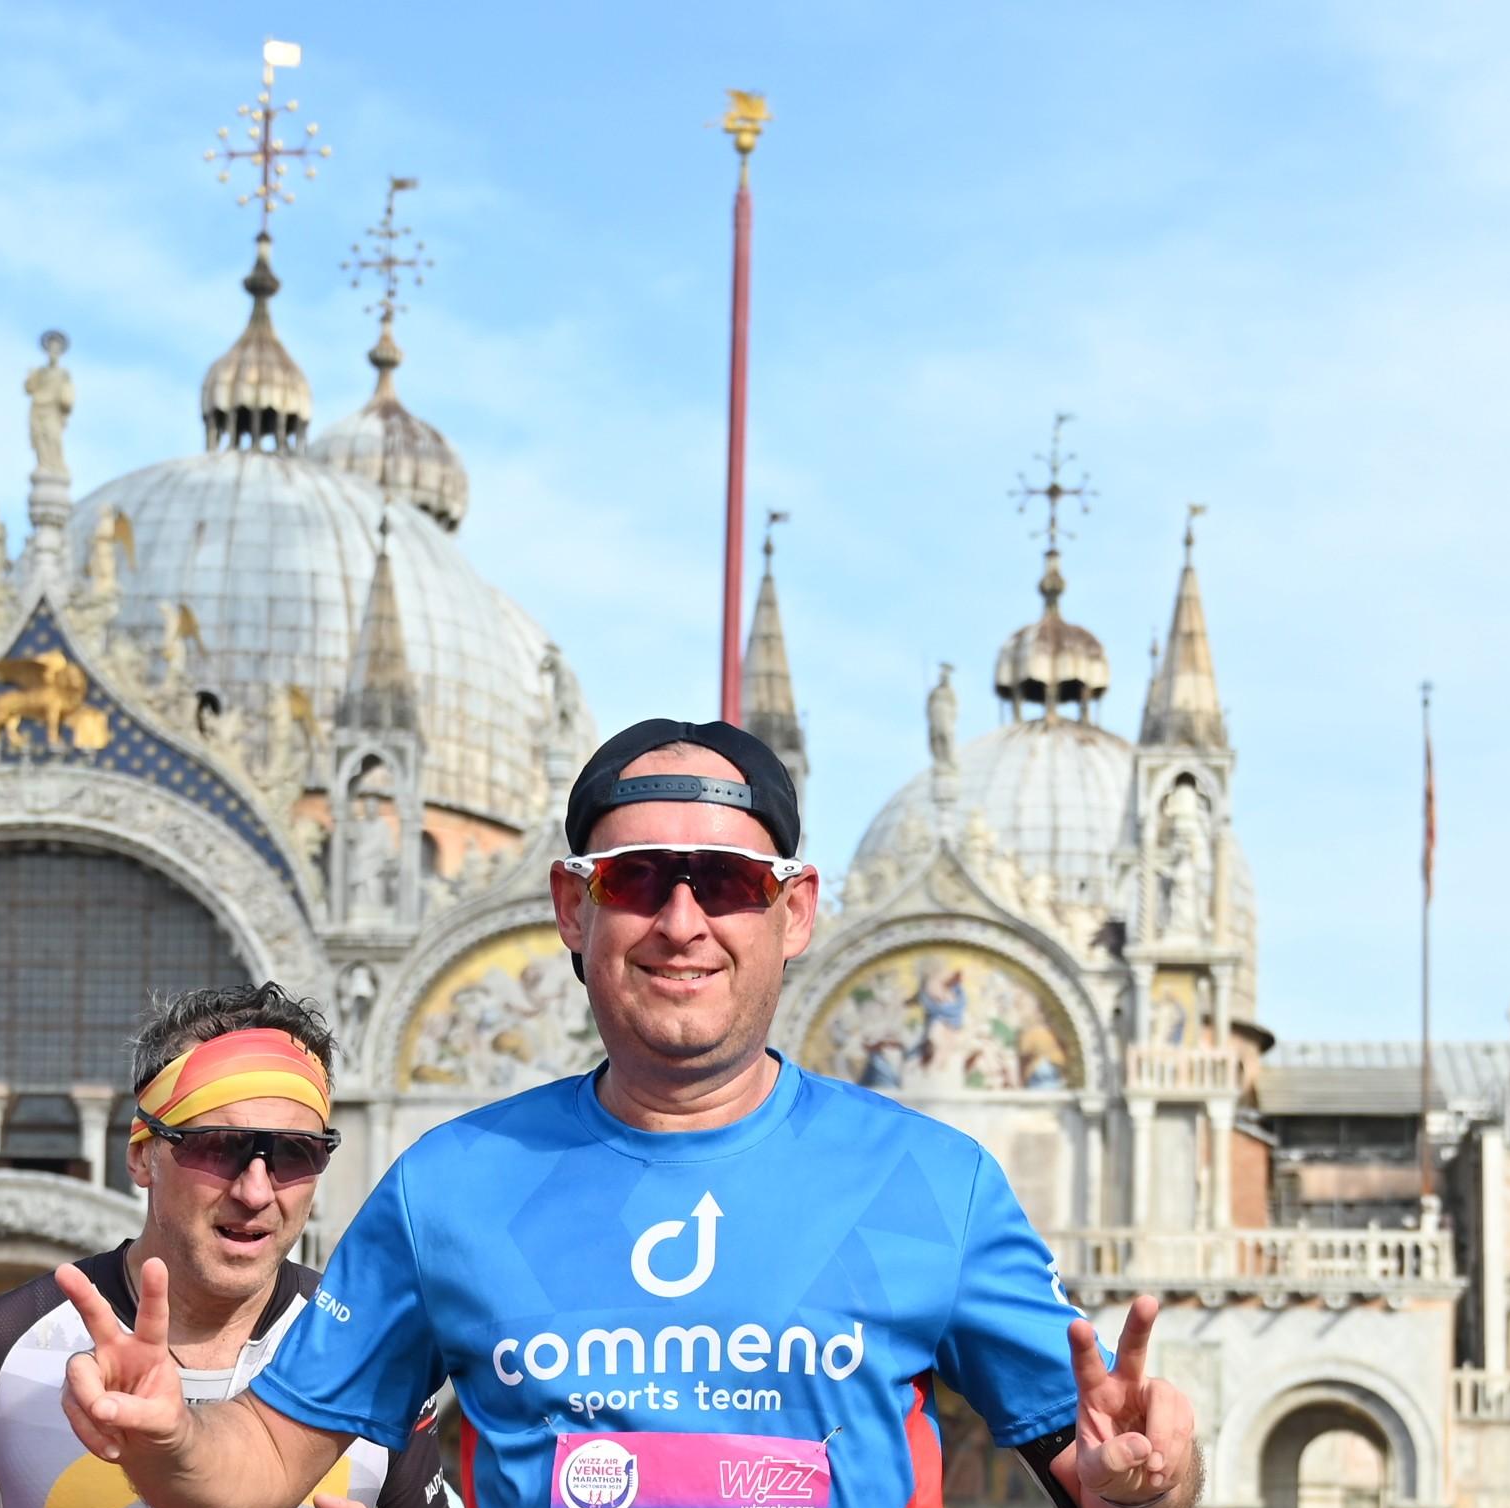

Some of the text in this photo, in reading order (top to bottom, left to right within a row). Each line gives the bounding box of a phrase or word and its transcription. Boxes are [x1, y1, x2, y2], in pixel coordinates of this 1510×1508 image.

[493, 1321, 864, 1386] commend
[569, 1380, 782, 1420] sports team
[574, 1465, 623, 1476] VENICE
[578, 1457, 601, 1465] WIZZ
